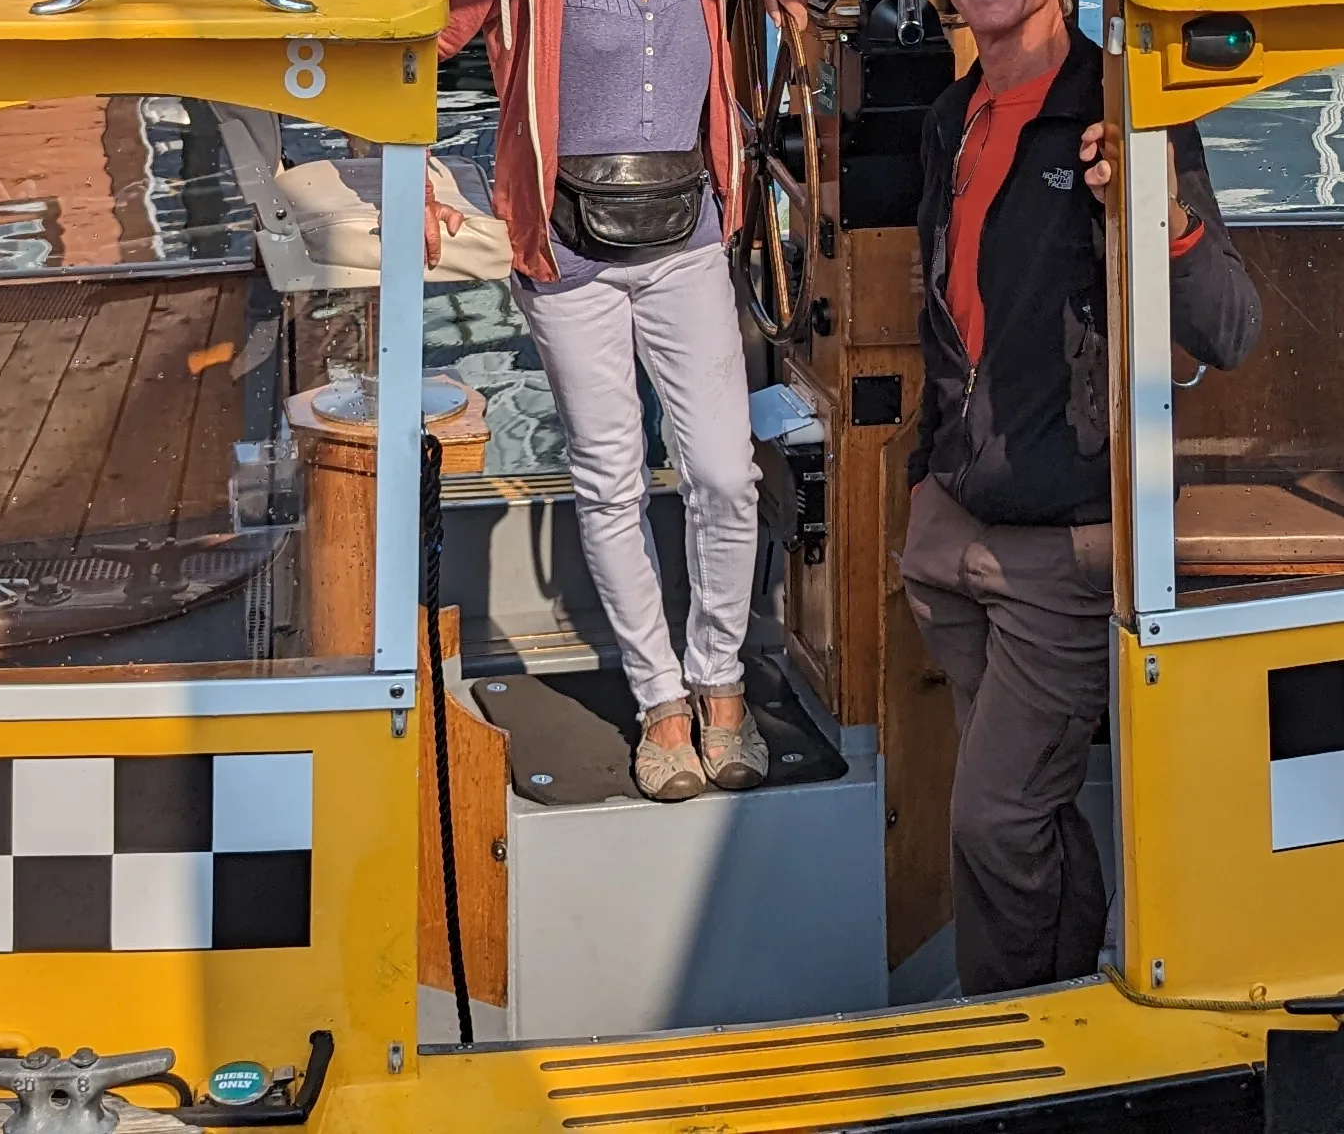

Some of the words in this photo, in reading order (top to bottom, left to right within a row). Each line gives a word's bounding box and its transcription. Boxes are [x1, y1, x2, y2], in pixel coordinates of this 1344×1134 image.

[284, 37, 326, 100] 8
[214, 1071, 260, 1082] DIESEL
[218, 1080, 253, 1090] ONLY
